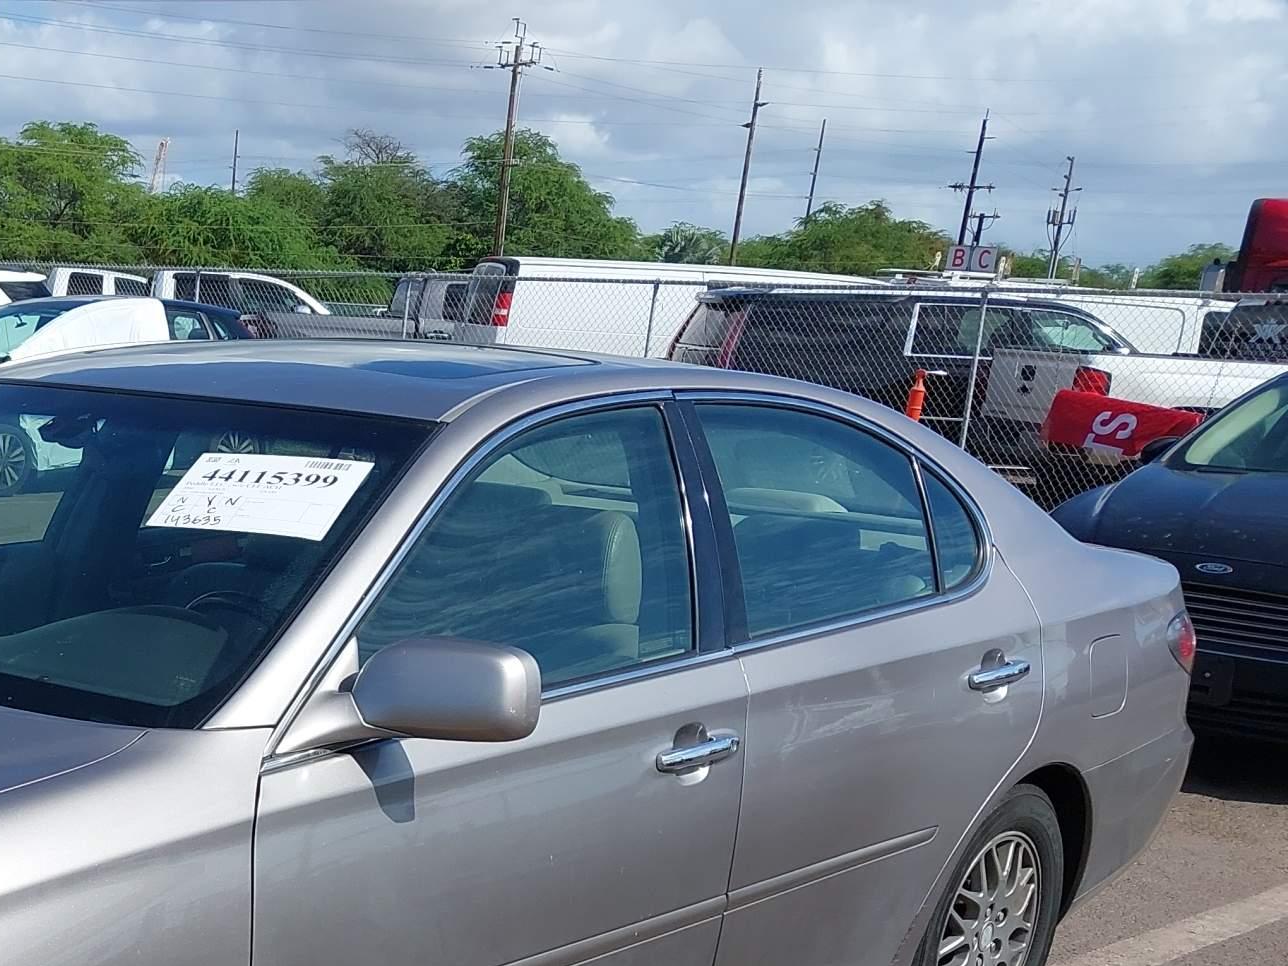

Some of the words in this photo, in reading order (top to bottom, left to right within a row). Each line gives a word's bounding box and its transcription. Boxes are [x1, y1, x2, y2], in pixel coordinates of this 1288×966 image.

[952, 248, 966, 268] B
[978, 249, 992, 269] C
[201, 468, 339, 489] 44115399
